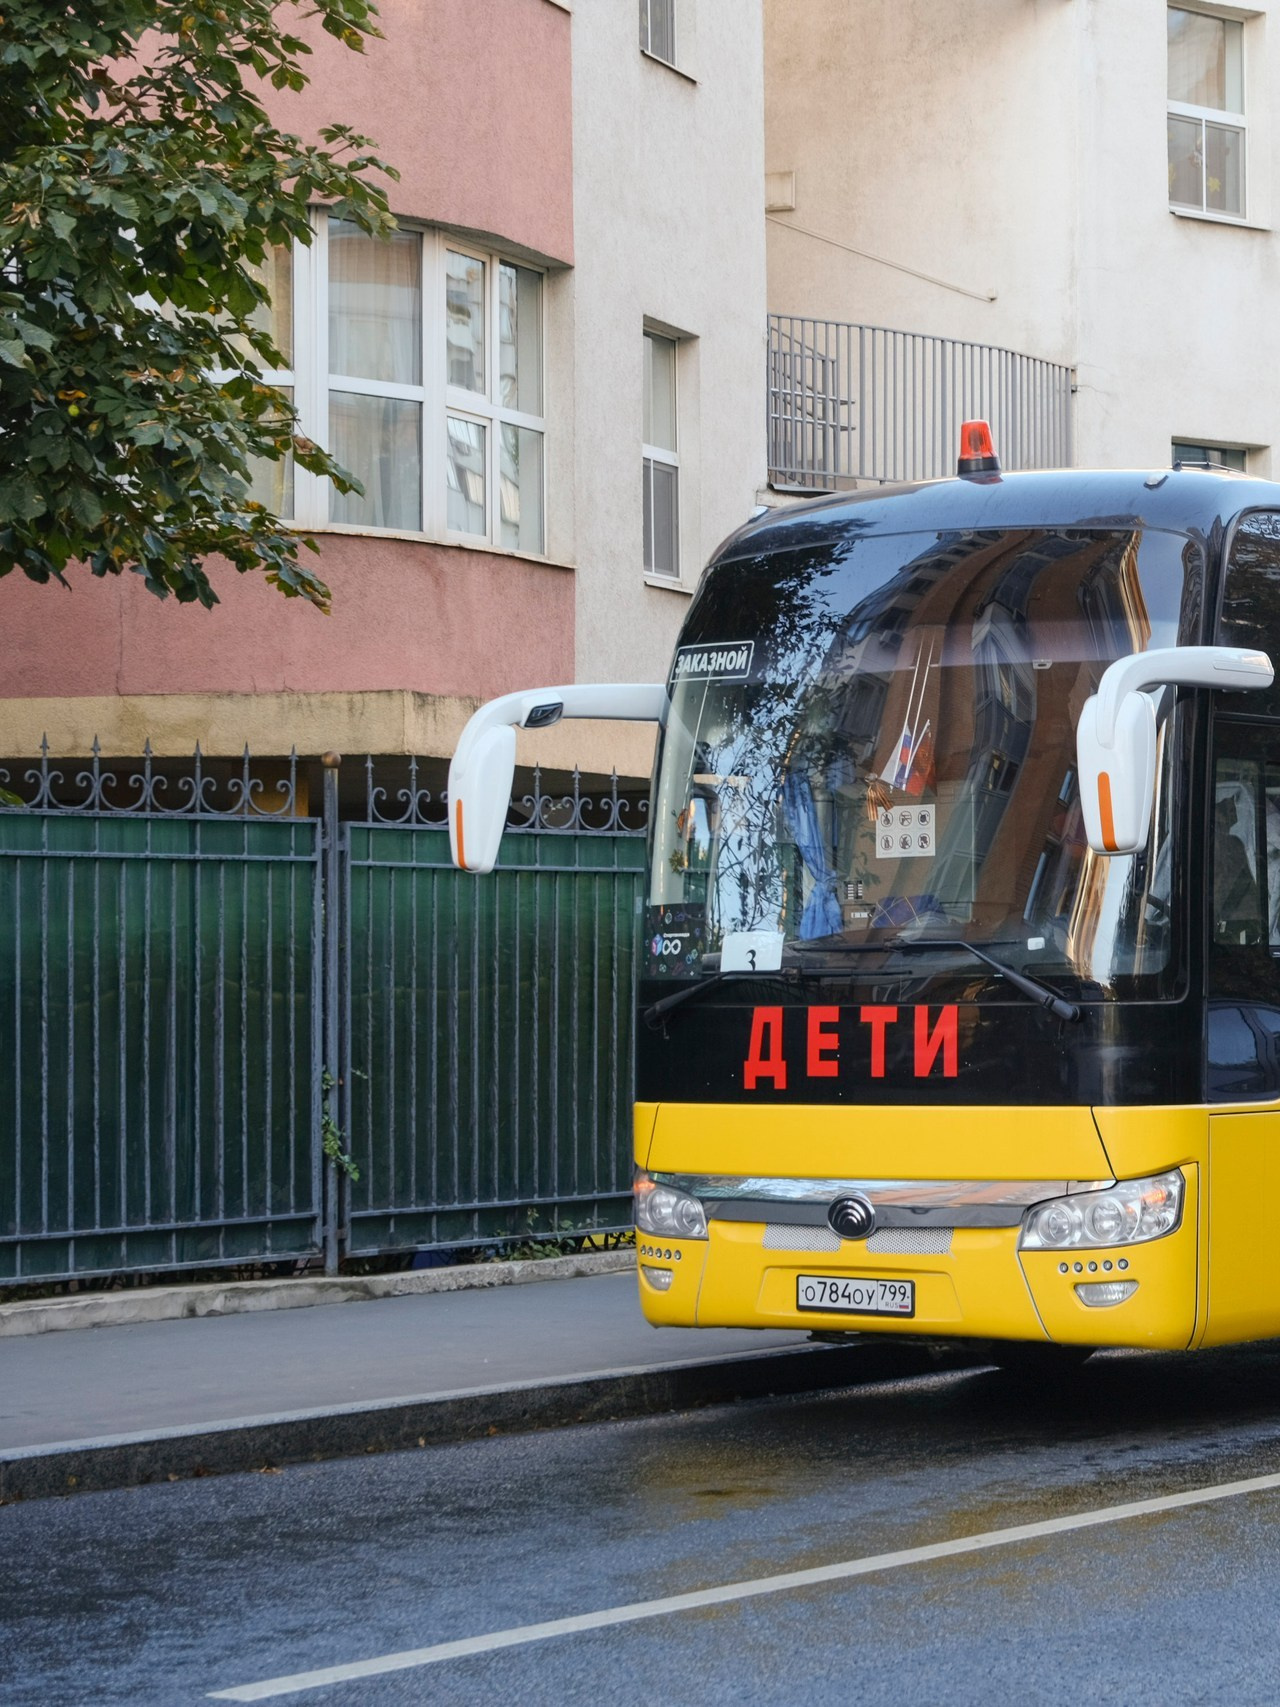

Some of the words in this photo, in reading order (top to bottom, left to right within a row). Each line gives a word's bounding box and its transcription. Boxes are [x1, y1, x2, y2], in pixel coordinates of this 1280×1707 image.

[675, 646, 749, 674] ЗАКАЗНОЙ
[745, 949, 757, 972] 3
[744, 1004, 958, 1089] ДЕТИ
[879, 1283, 907, 1302] 799
[885, 1301, 899, 1309] RUS
